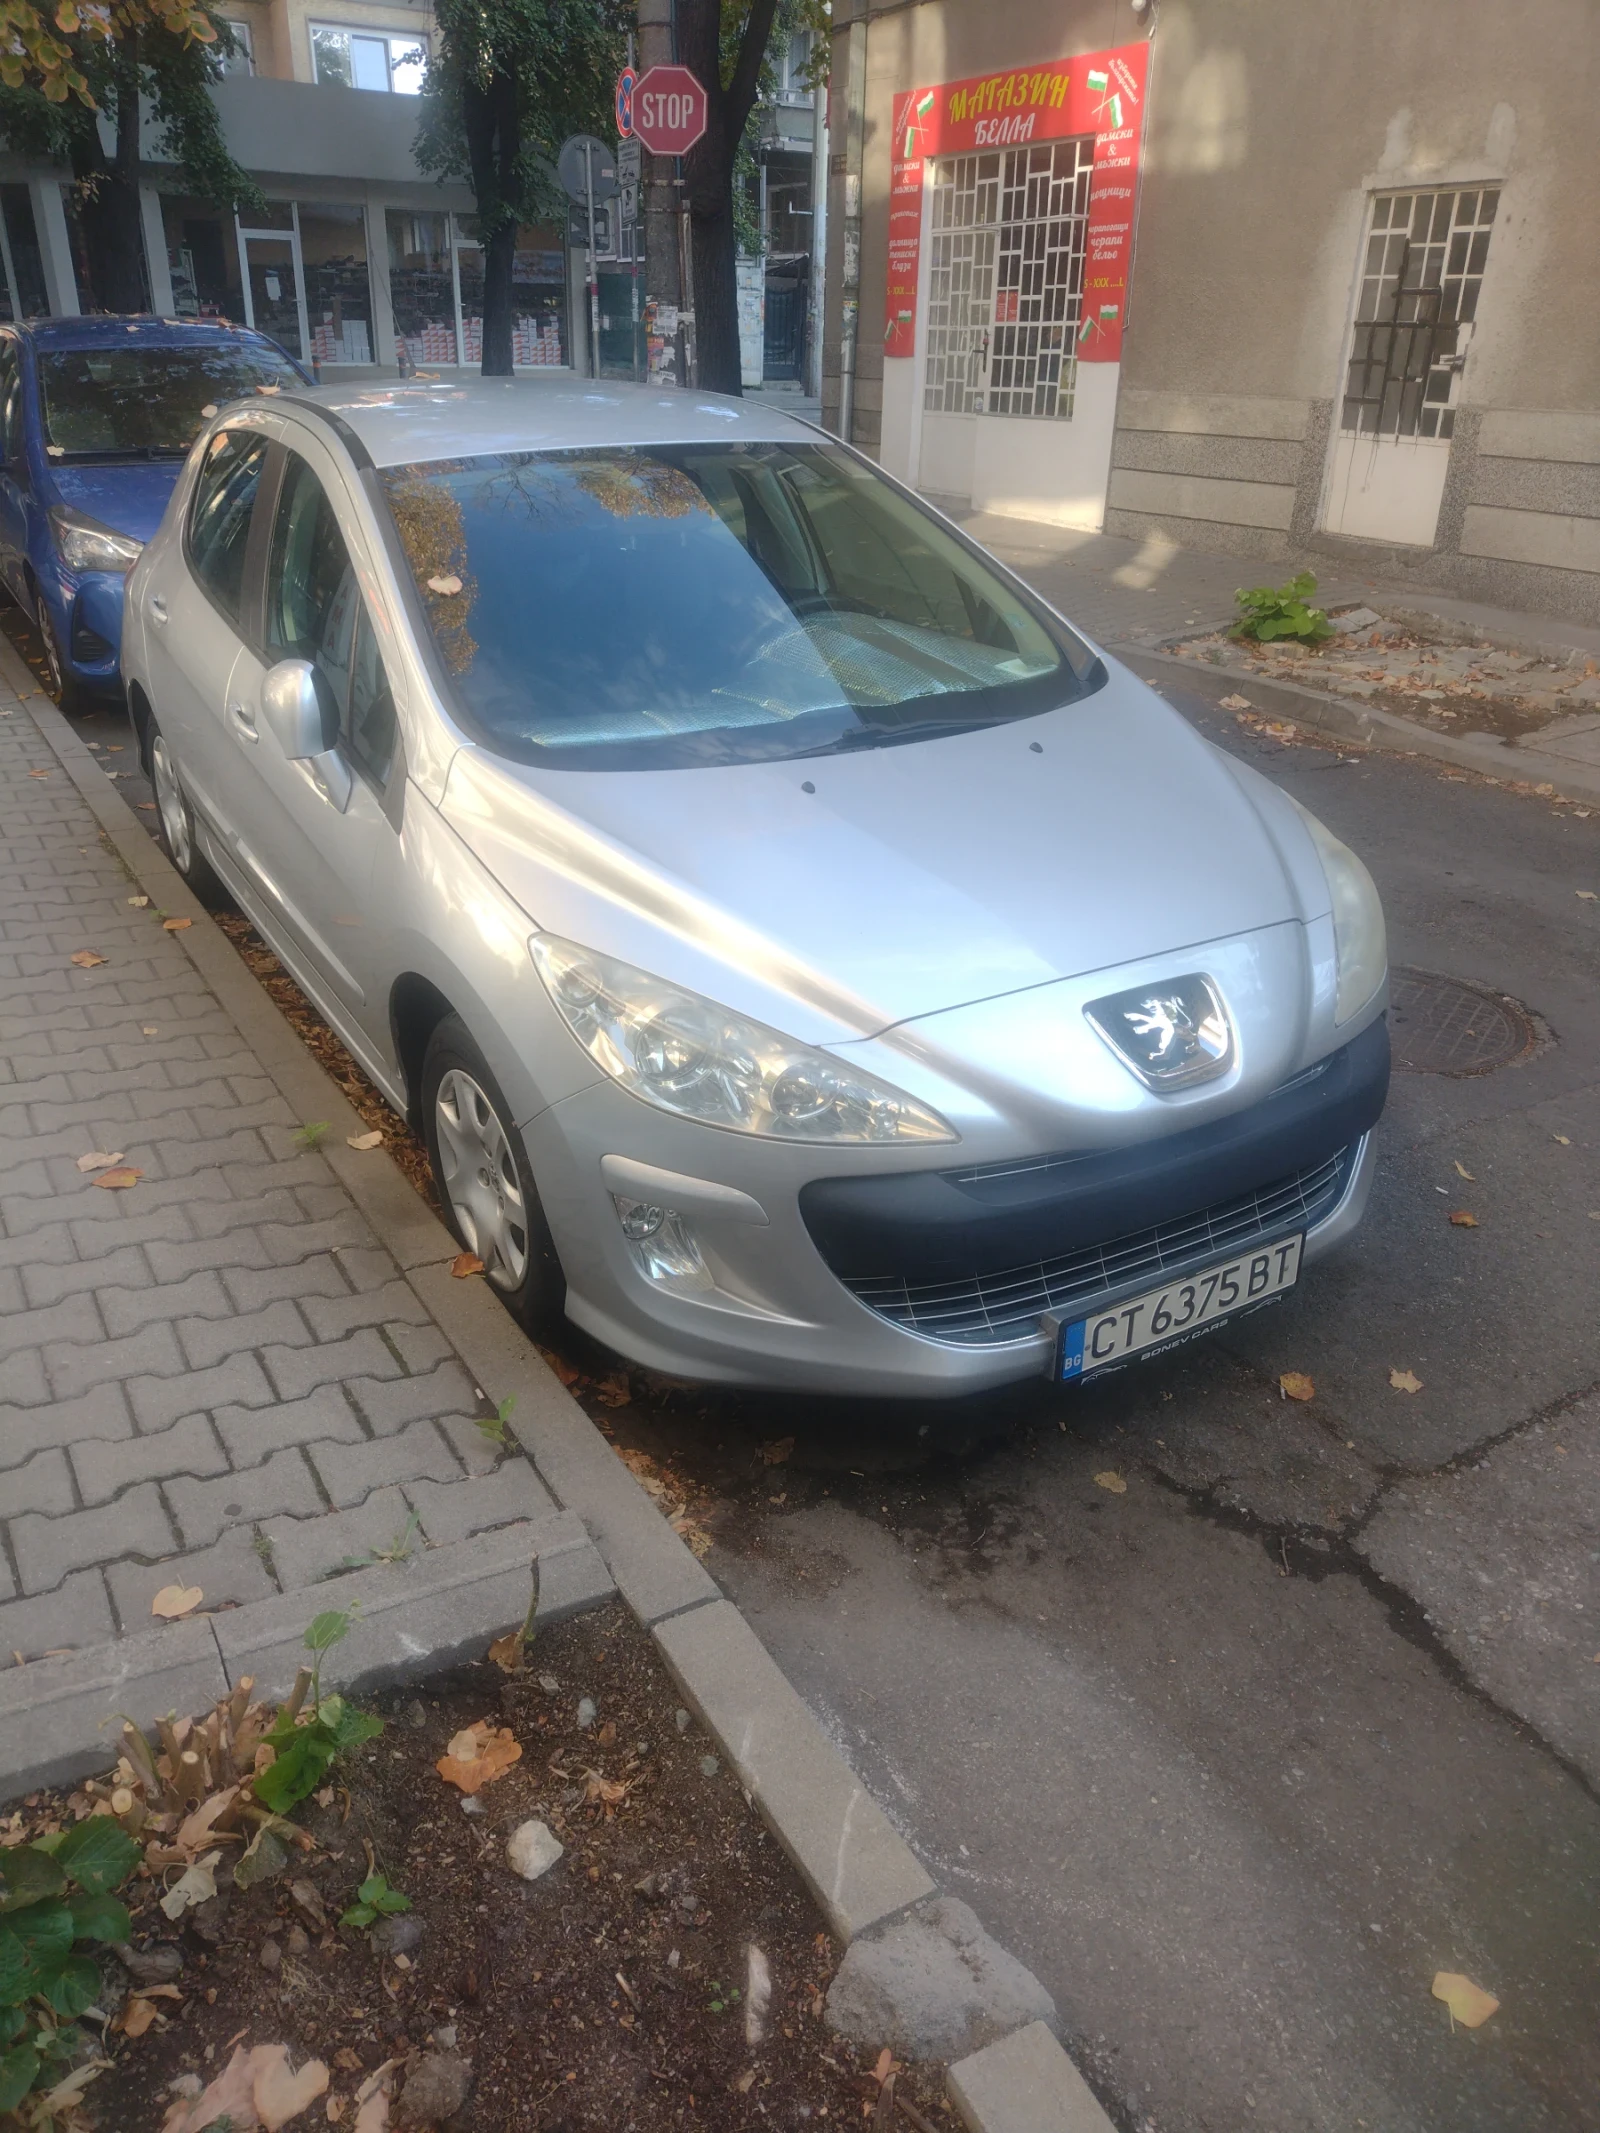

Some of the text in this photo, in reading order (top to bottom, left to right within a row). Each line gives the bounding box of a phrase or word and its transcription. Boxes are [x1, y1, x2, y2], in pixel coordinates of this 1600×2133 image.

[642, 93, 694, 129] STOP
[949, 73, 1069, 125] МАГАЗИН
[975, 112, 1035, 145] БЕЛЛА
[1096, 129, 1134, 147] дамски
[1095, 156, 1131, 170] мъжки
[1091, 236, 1123, 249] чорапи
[1092, 249, 1118, 260] бельо
[1091, 1242, 1296, 1359] CT 6375 BT
[1141, 1318, 1229, 1361] BONEV CARS
[1064, 1354, 1081, 1370] BG
